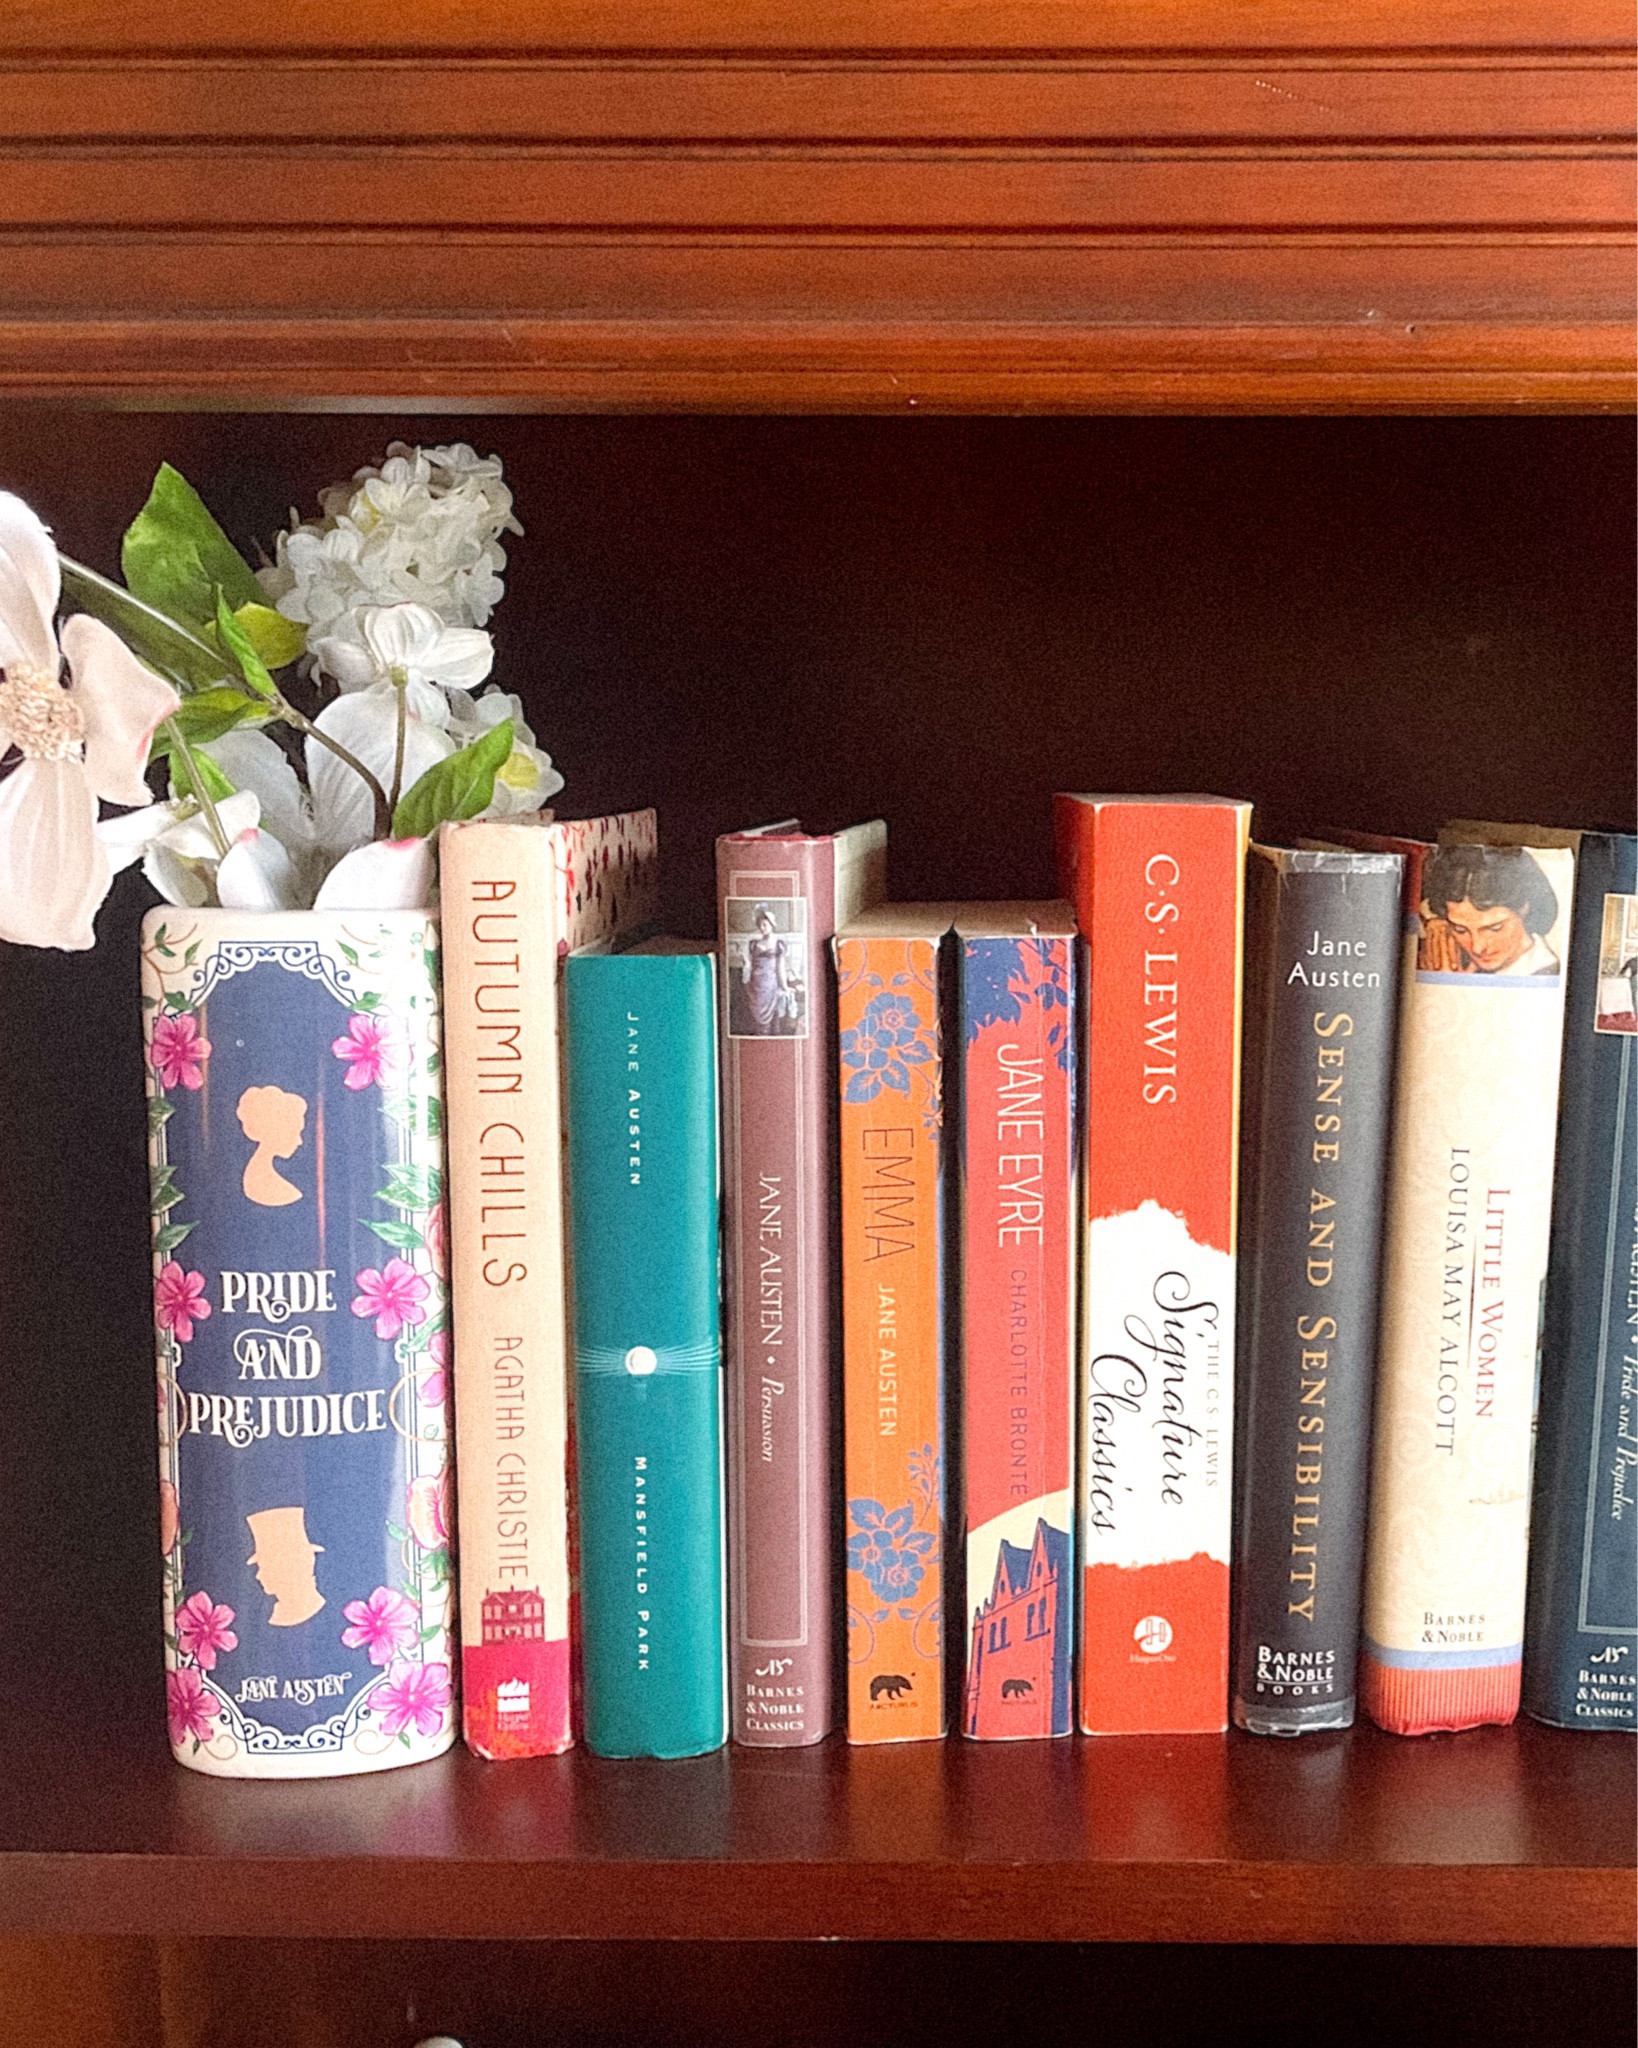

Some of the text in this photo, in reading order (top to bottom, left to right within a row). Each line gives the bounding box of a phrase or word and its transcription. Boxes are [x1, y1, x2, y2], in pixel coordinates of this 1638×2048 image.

[1287, 962, 1381, 988] Austen
[1306, 930, 1368, 957] Jane
[471, 879, 528, 1288] AUTUMN CHILLS
[627, 1011, 641, 1186] JANE AUSTEN
[1143, 950, 1179, 1104] LEWIS
[862, 1128, 916, 1263] EMMA
[997, 1043, 1044, 1249] JANE EYRE
[220, 1270, 337, 1323] PRIDE
[233, 1325, 322, 1381] AND
[760, 1172, 785, 1463] JANE AUSTEN Persuasion
[878, 1283, 897, 1437] JANE AUSTEN
[1010, 1269, 1028, 1398] CHARLOTTE
[1207, 1340, 1219, 1379] THE
[1288, 1010, 1354, 1622] SENSE AND SENSIBILITY
[1435, 1147, 1470, 1456] LOUISA MAY ALCOTT
[1475, 1188, 1511, 1418] LITTLE WOMEN
[187, 1389, 388, 1449] PREJUDICE
[494, 1337, 529, 1579] AGATHA CHRISTIE
[1087, 1354, 1148, 1536] Classics
[1123, 1271, 1220, 1505] Signature
[1206, 1429, 1218, 1487] LEWIS
[1611, 1446, 1638, 1521] Prejudice
[634, 1456, 649, 1671] MANSFIELD PARK
[235, 1671, 353, 1705] JANE AUSTEN
[1256, 1682, 1334, 1696] BOOKS
